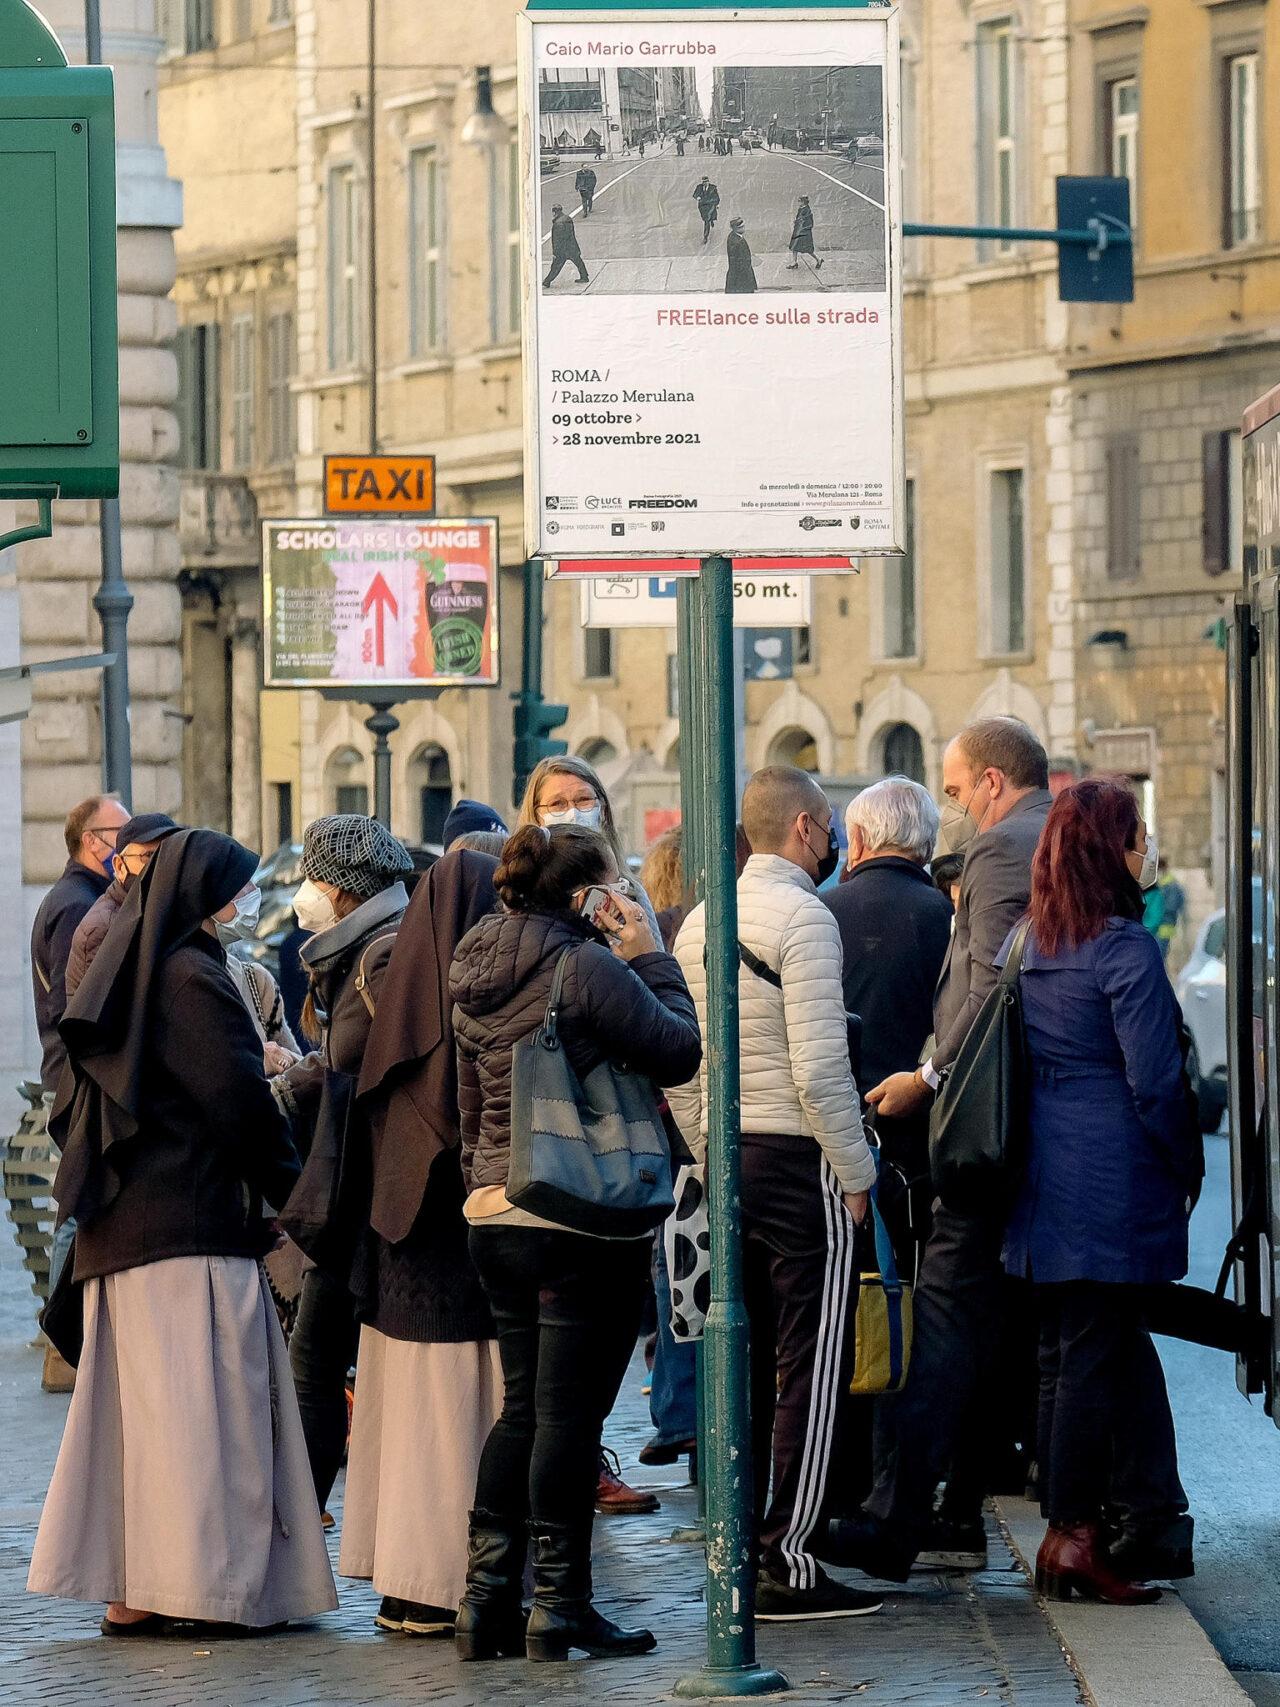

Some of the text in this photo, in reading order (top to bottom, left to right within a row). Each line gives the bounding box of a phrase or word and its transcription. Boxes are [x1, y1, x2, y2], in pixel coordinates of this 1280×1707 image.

[545, 41, 717, 55] Caio Mario Garrubba
[657, 307, 879, 326] FREElance sulla strada
[551, 369, 602, 383] ROMA
[561, 390, 619, 404] Palazzo
[622, 389, 695, 403] Merulana
[552, 413, 571, 427] 09
[574, 411, 633, 425] ottobre
[563, 433, 581, 446] 28
[584, 432, 662, 446] novembre
[665, 433, 701, 445] 2021
[332, 468, 425, 501] TAXI
[628, 498, 698, 510] FREEDOM
[276, 529, 481, 550] SCHOLARS LOUNGE
[762, 582, 798, 598] mt.
[429, 592, 484, 608] GUINNESS
